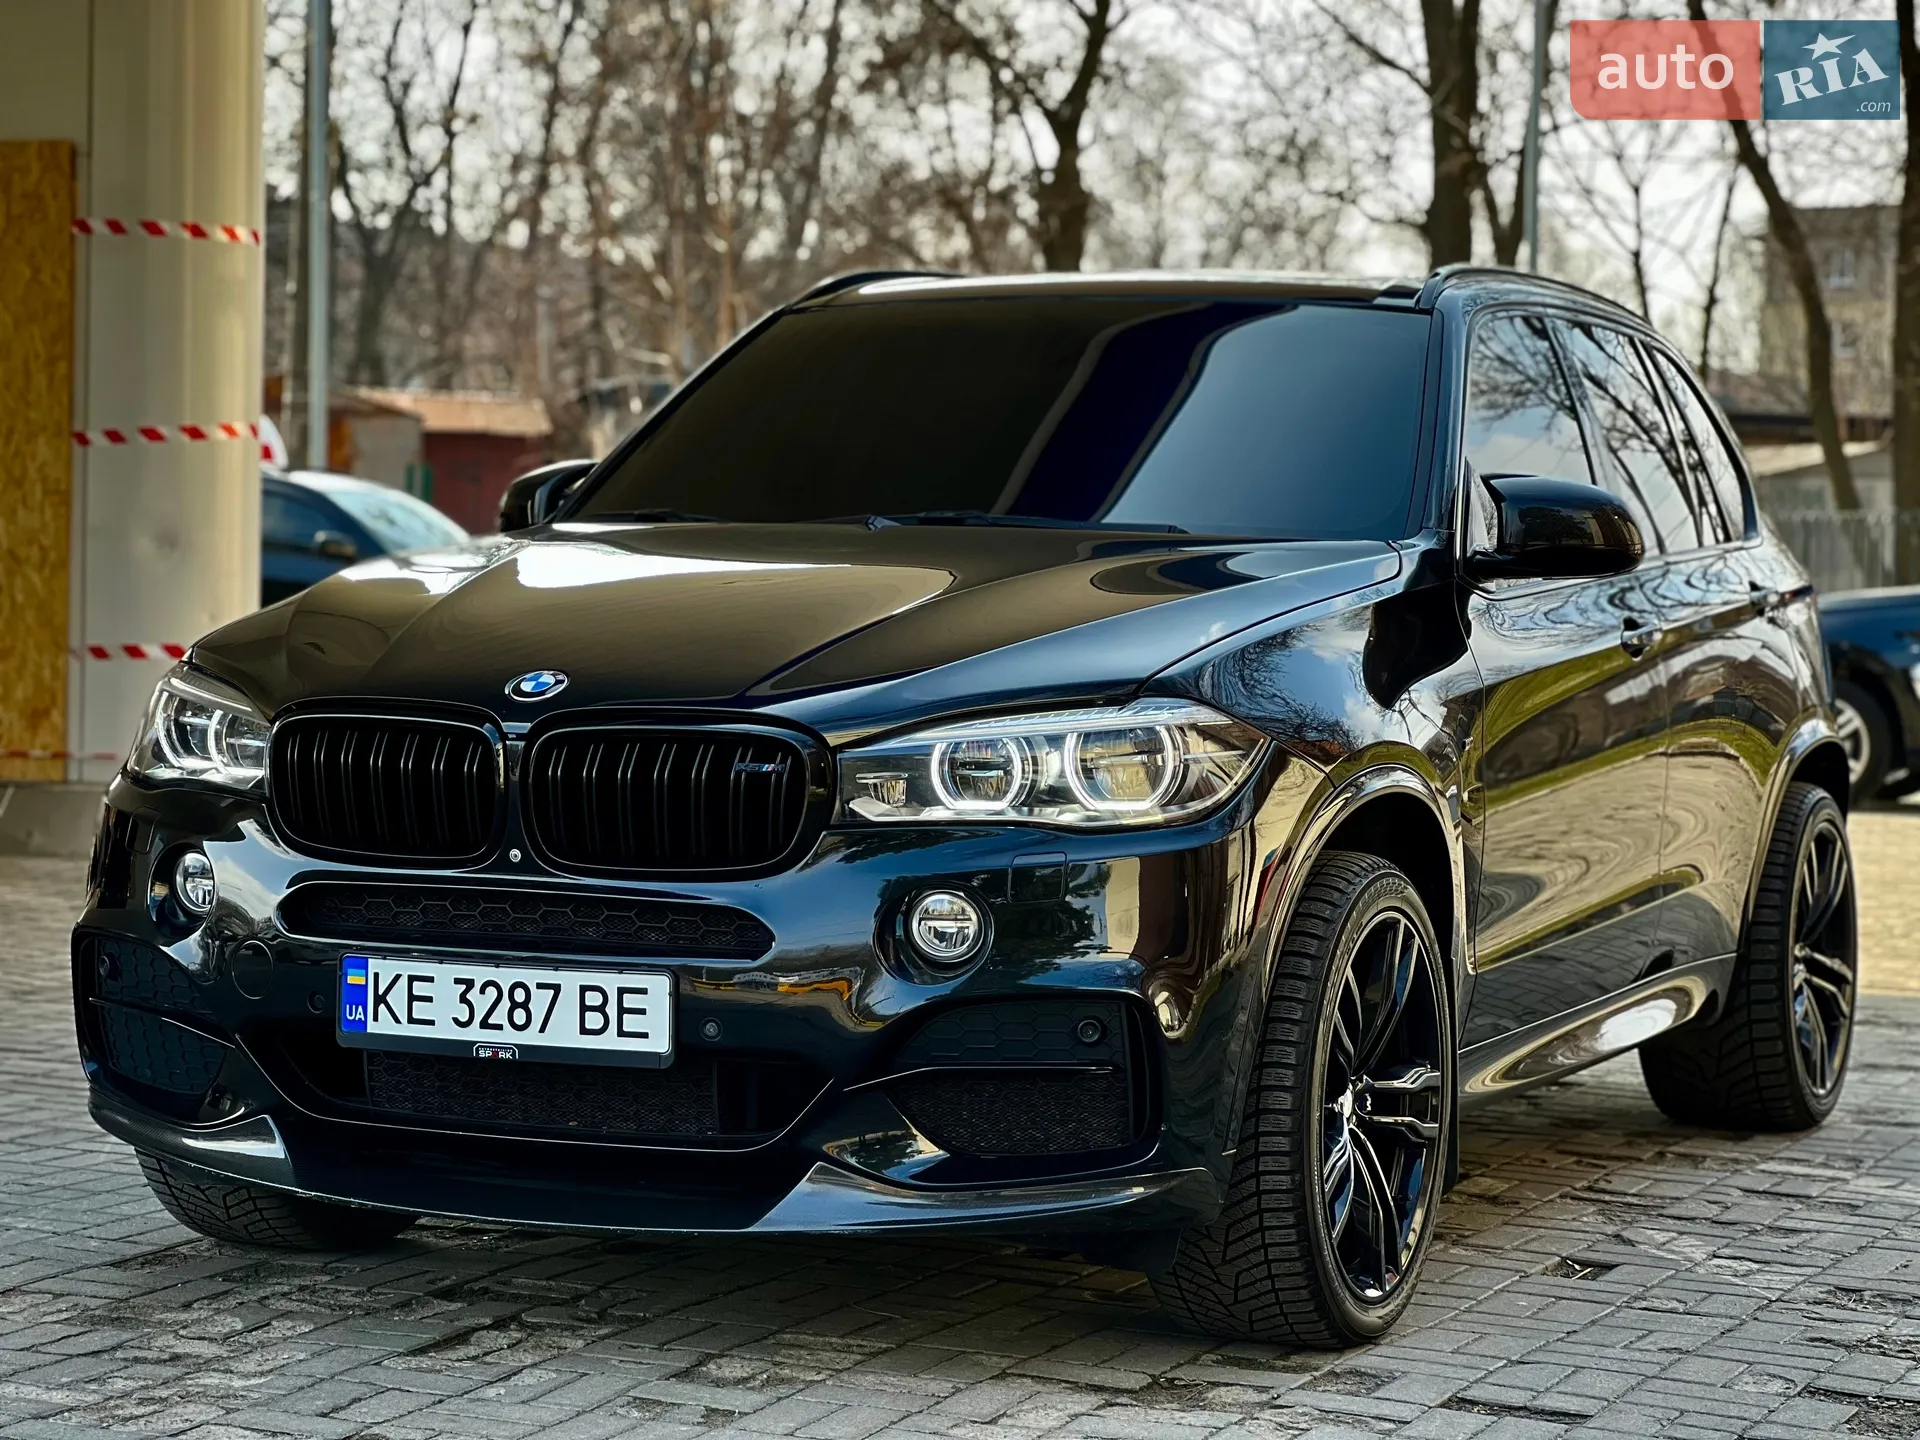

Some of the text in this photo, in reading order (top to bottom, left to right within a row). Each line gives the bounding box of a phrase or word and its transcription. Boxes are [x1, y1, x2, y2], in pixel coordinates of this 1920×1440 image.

[346, 1004, 365, 1021] UA
[372, 971, 650, 1039] KE 3287 BE
[479, 1050, 513, 1059] SPARK
